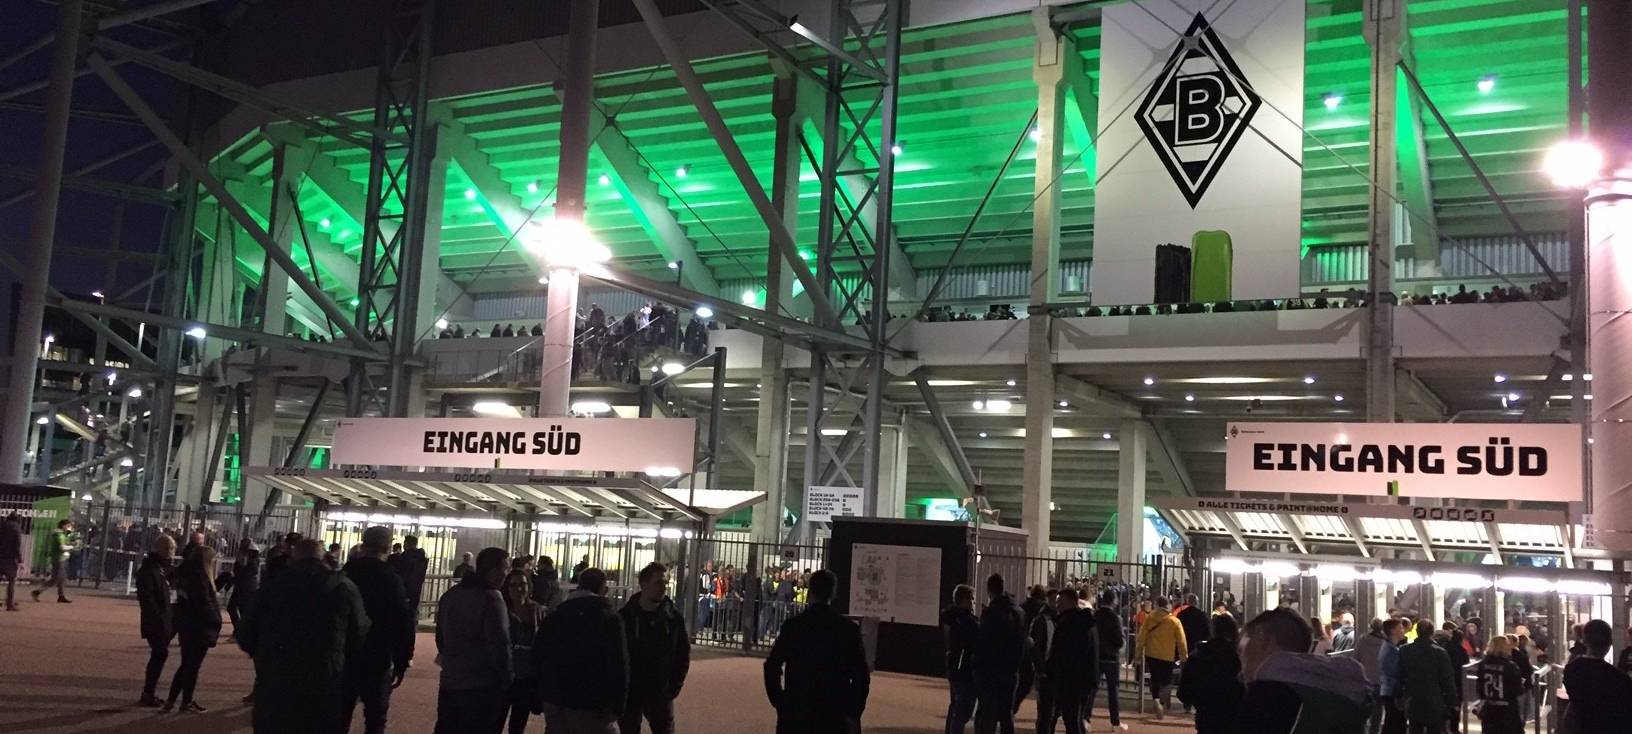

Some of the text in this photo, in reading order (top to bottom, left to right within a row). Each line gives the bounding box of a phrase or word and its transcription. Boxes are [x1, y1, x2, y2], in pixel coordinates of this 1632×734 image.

[1174, 74, 1226, 147] B
[423, 425, 581, 455] EINGANG SÜD
[1253, 437, 1548, 476] EINGANG SÜD
[1206, 501, 1228, 509] ALLE
[1230, 502, 1268, 511] TICKETS
[784, 550, 794, 558] 20
[1103, 568, 1114, 577] 21
[1484, 673, 1504, 699] 24
